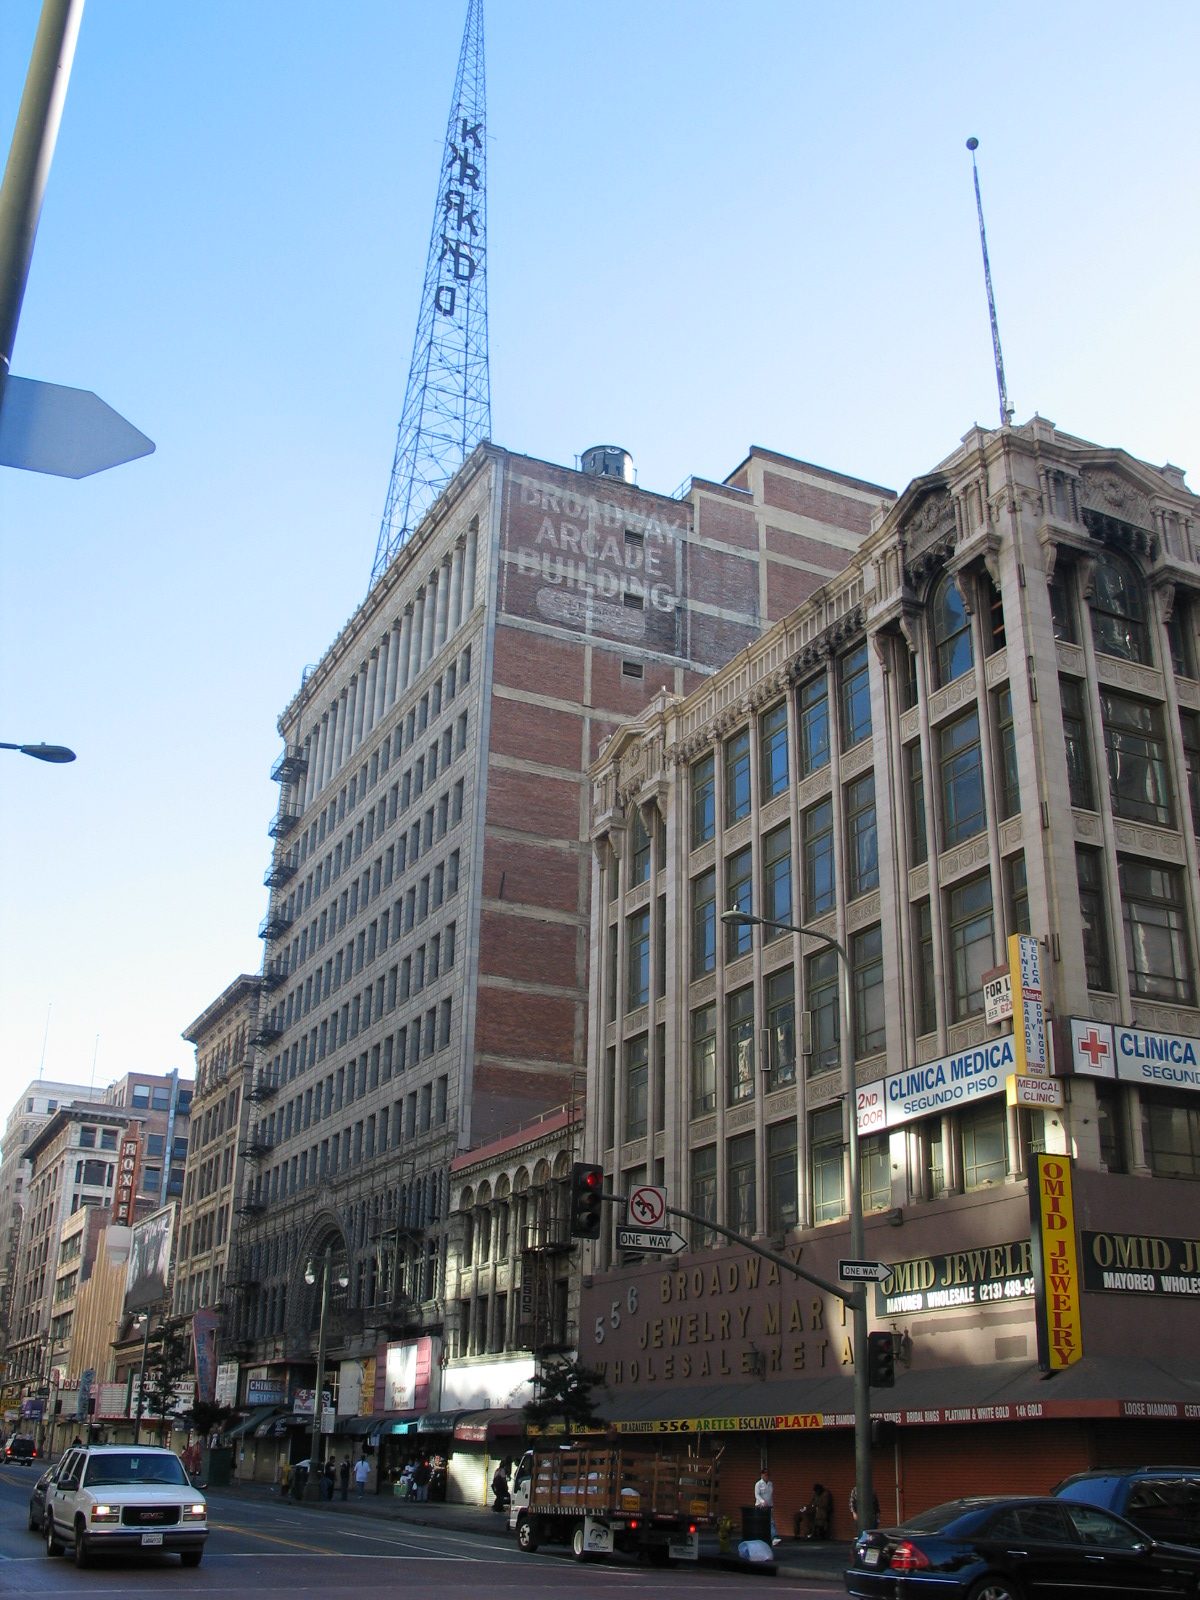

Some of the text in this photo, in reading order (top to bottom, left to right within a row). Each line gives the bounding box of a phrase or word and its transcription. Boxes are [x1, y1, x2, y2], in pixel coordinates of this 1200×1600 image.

[534, 515, 664, 577] ARCADE
[517, 546, 680, 613] BUILDING
[1019, 936, 1031, 988] CLINICA
[1029, 938, 1040, 985] MEDICA
[985, 980, 1002, 999] FOR
[992, 993, 1010, 1006] OFFICE
[1023, 1001, 1032, 1054] SABADOS
[1036, 1003, 1045, 1062] DOMINGOS
[1120, 1033, 1197, 1066] CLINICA
[888, 1042, 1014, 1102] CLINICA MEDICA
[1017, 1078, 1060, 1093] MEDICAL
[857, 1092, 878, 1110] 2ND
[903, 1075, 998, 1115] SEGUNDO PISO
[1023, 1090, 1056, 1104] CLINIC
[119, 1142, 136, 1219] ROXIE
[620, 1233, 671, 1248] ONE WAY
[1092, 1234, 1172, 1271] OMID
[659, 1247, 804, 1304] BROADWAY
[845, 1266, 878, 1277] ONE WAY
[880, 1258, 936, 1296] OMID
[1042, 1162, 1075, 1366] OMID JEWELRY
[1102, 1272, 1155, 1291] MAYOREO
[594, 1285, 639, 1345] 556
[886, 1293, 923, 1314] MAYOREO
[926, 1286, 975, 1308] WHOLESALE
[979, 1282, 1003, 1301] (213)
[638, 1295, 848, 1351] JEWELRY MART
[594, 1350, 751, 1385] WHOLESALE
[250, 1380, 281, 1392] CHINESE
[658, 1420, 690, 1432] 556
[695, 1418, 736, 1431] ARETES
[738, 1416, 776, 1430] ESCLAVA
[776, 1414, 820, 1428] PLATA
[906, 1410, 924, 1423] BRIDAL
[924, 1409, 940, 1422] RINGS
[944, 1408, 971, 1422] PLATINUM
[977, 1407, 995, 1420] WHITE
[994, 1405, 1010, 1419] GOLD
[1027, 1404, 1043, 1417] GOLD
[1124, 1402, 1146, 1415] LOOSE
[1146, 1403, 1178, 1417] DIAMOND
